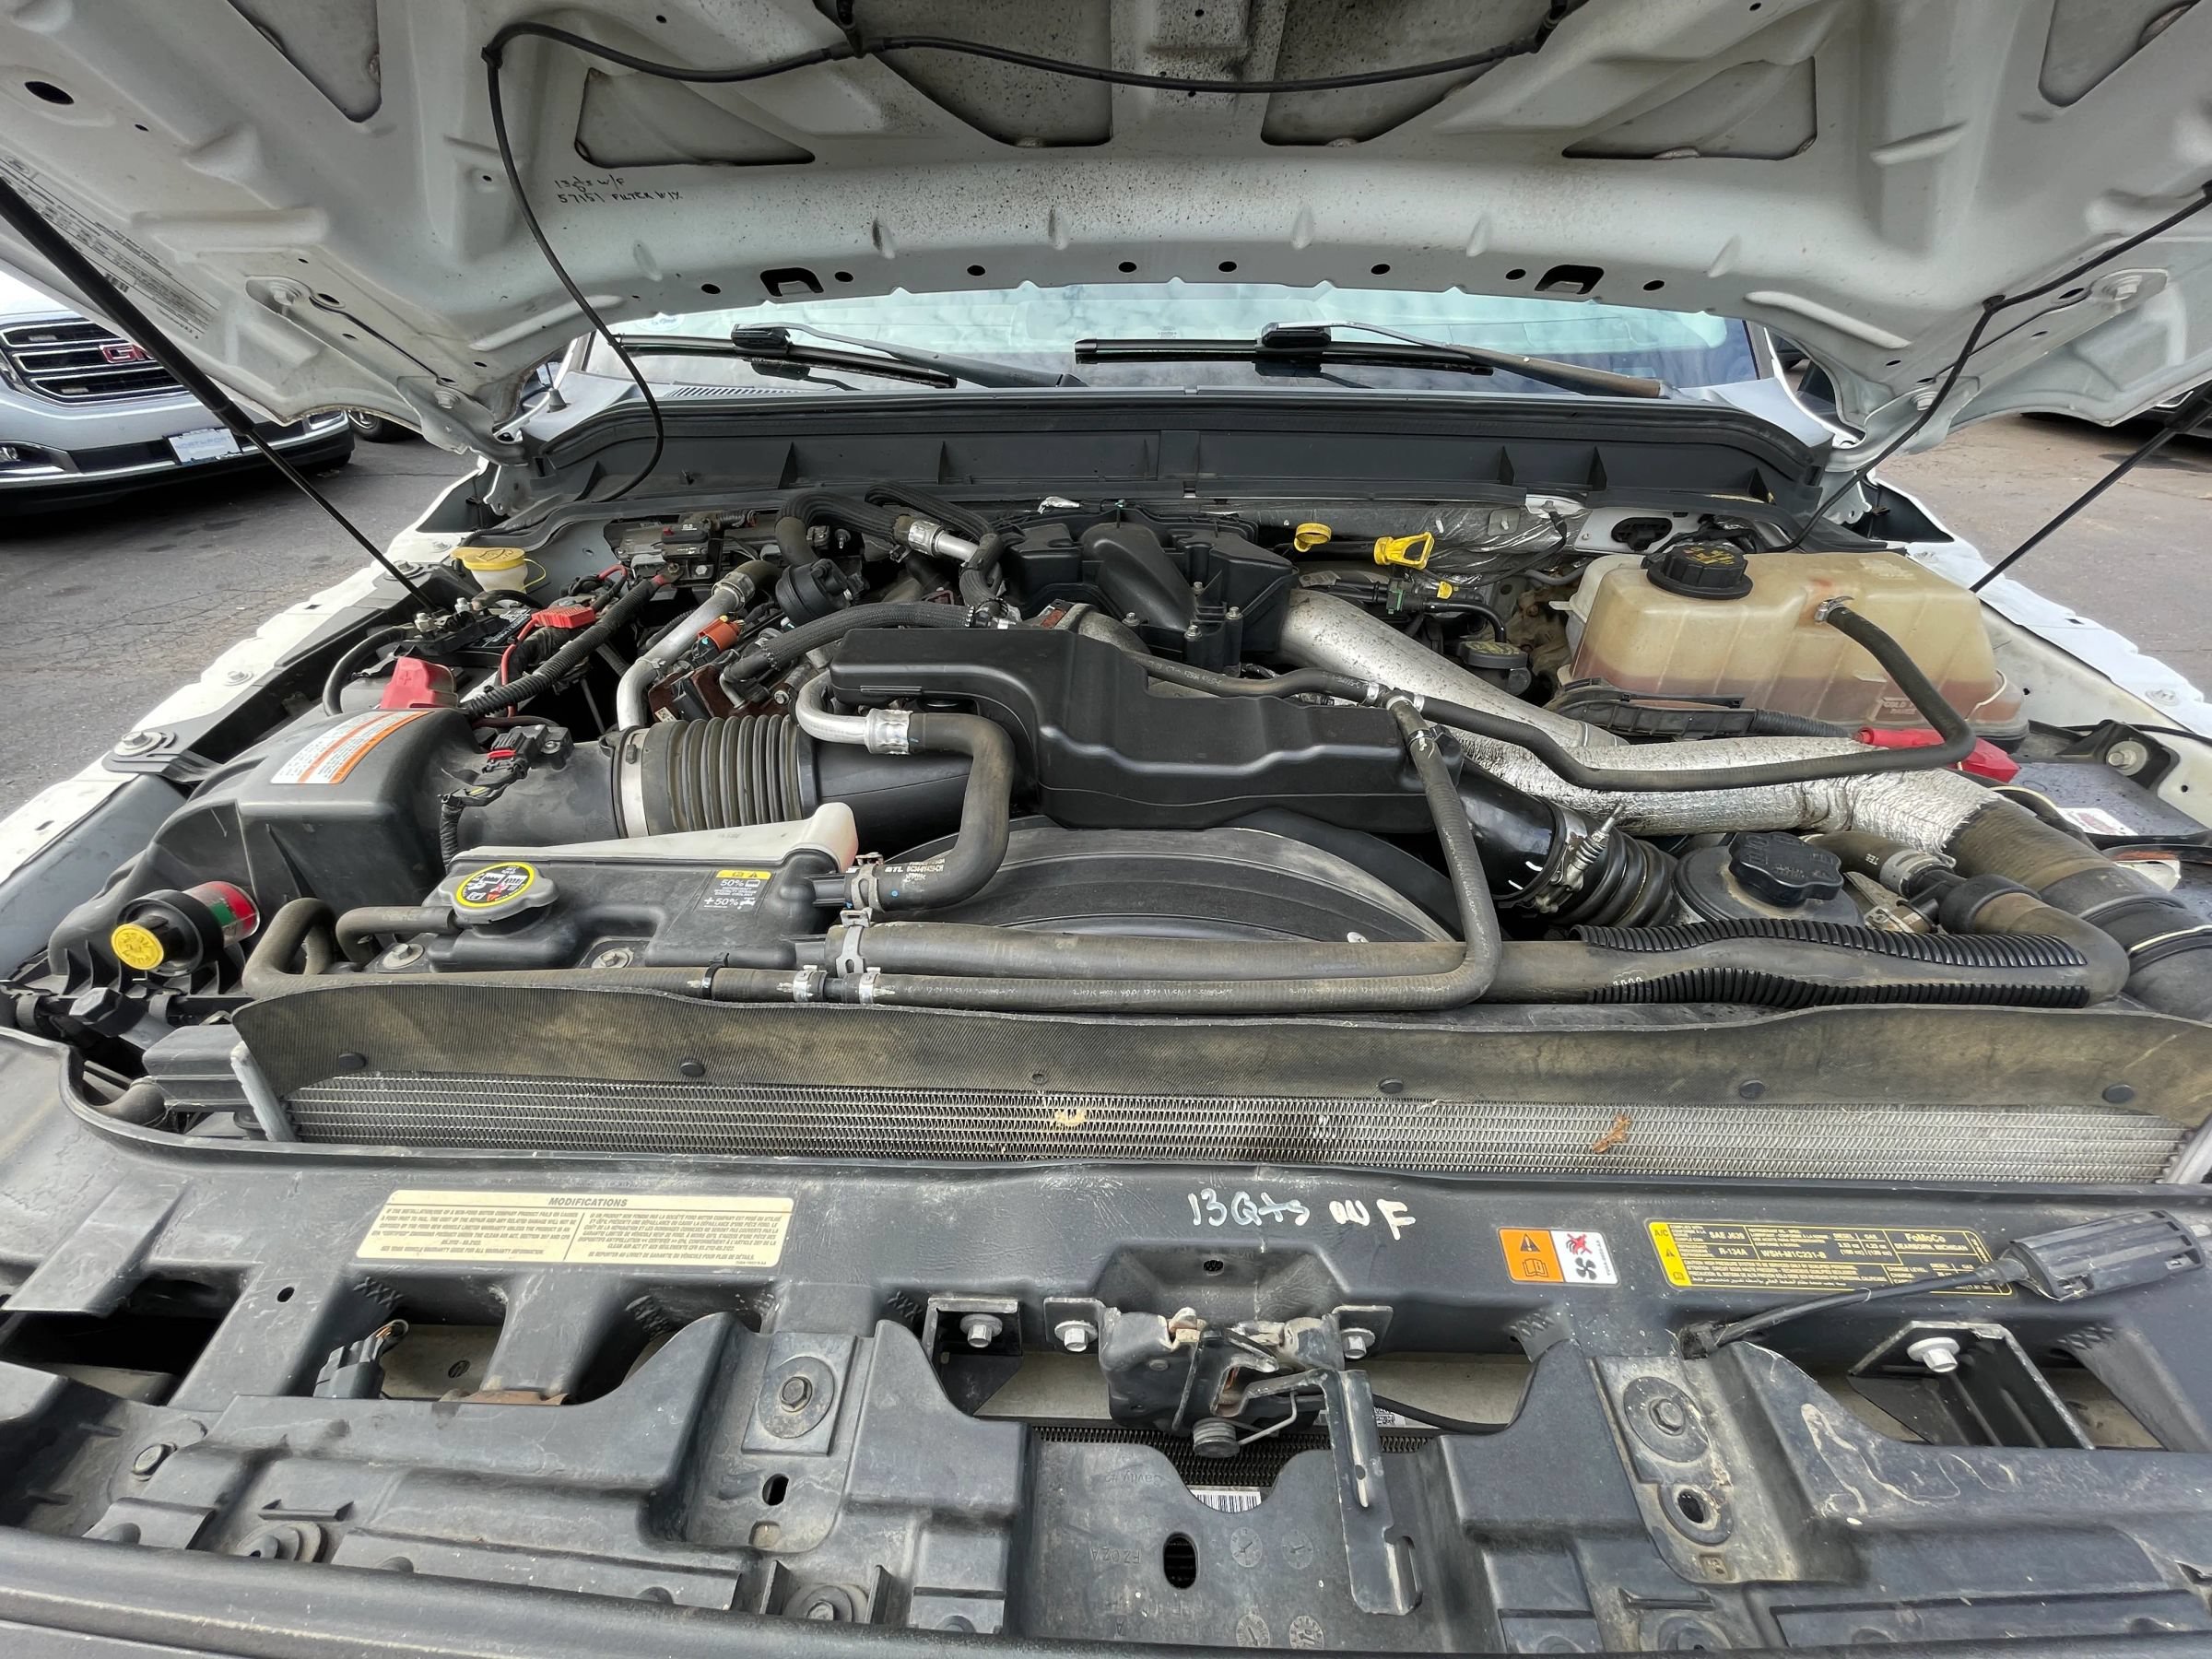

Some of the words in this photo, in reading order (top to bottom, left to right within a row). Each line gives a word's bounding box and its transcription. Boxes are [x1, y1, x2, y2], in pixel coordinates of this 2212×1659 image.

[547, 1197, 628, 1207] MODIFICATIONS
[1709, 1230, 1726, 1240] SAE
[1904, 1233, 1947, 1243] FoMoCo
[1718, 1248, 1748, 1256] R-134A
